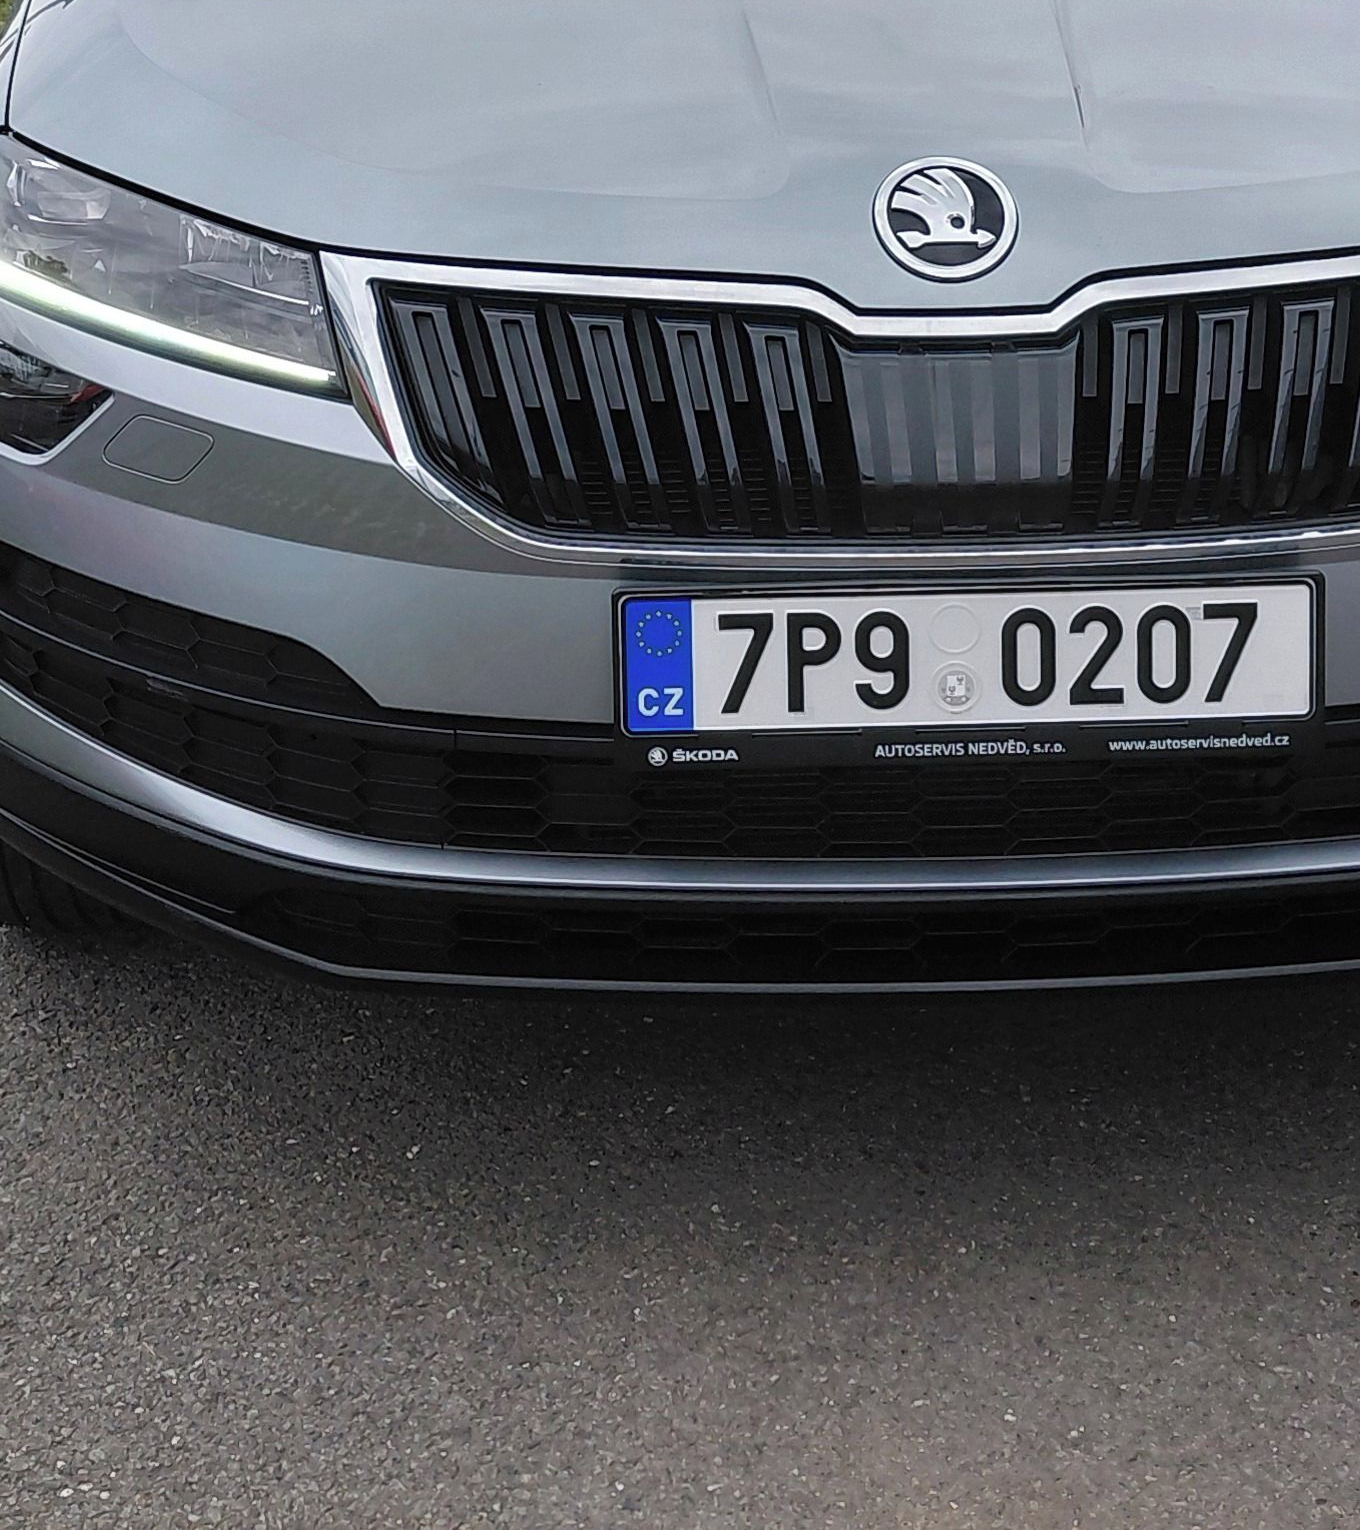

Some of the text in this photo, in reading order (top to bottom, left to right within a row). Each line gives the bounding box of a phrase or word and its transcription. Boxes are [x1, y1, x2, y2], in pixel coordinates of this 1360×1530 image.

[718, 602, 1258, 713] 7P9 0207
[637, 687, 684, 717] CZ
[875, 739, 1066, 758] AUTOSERVIS NEDVĚD, s.r.o.
[1109, 732, 1290, 752] www.autoservisnedved.cz
[672, 748, 739, 763] ŠKODA
